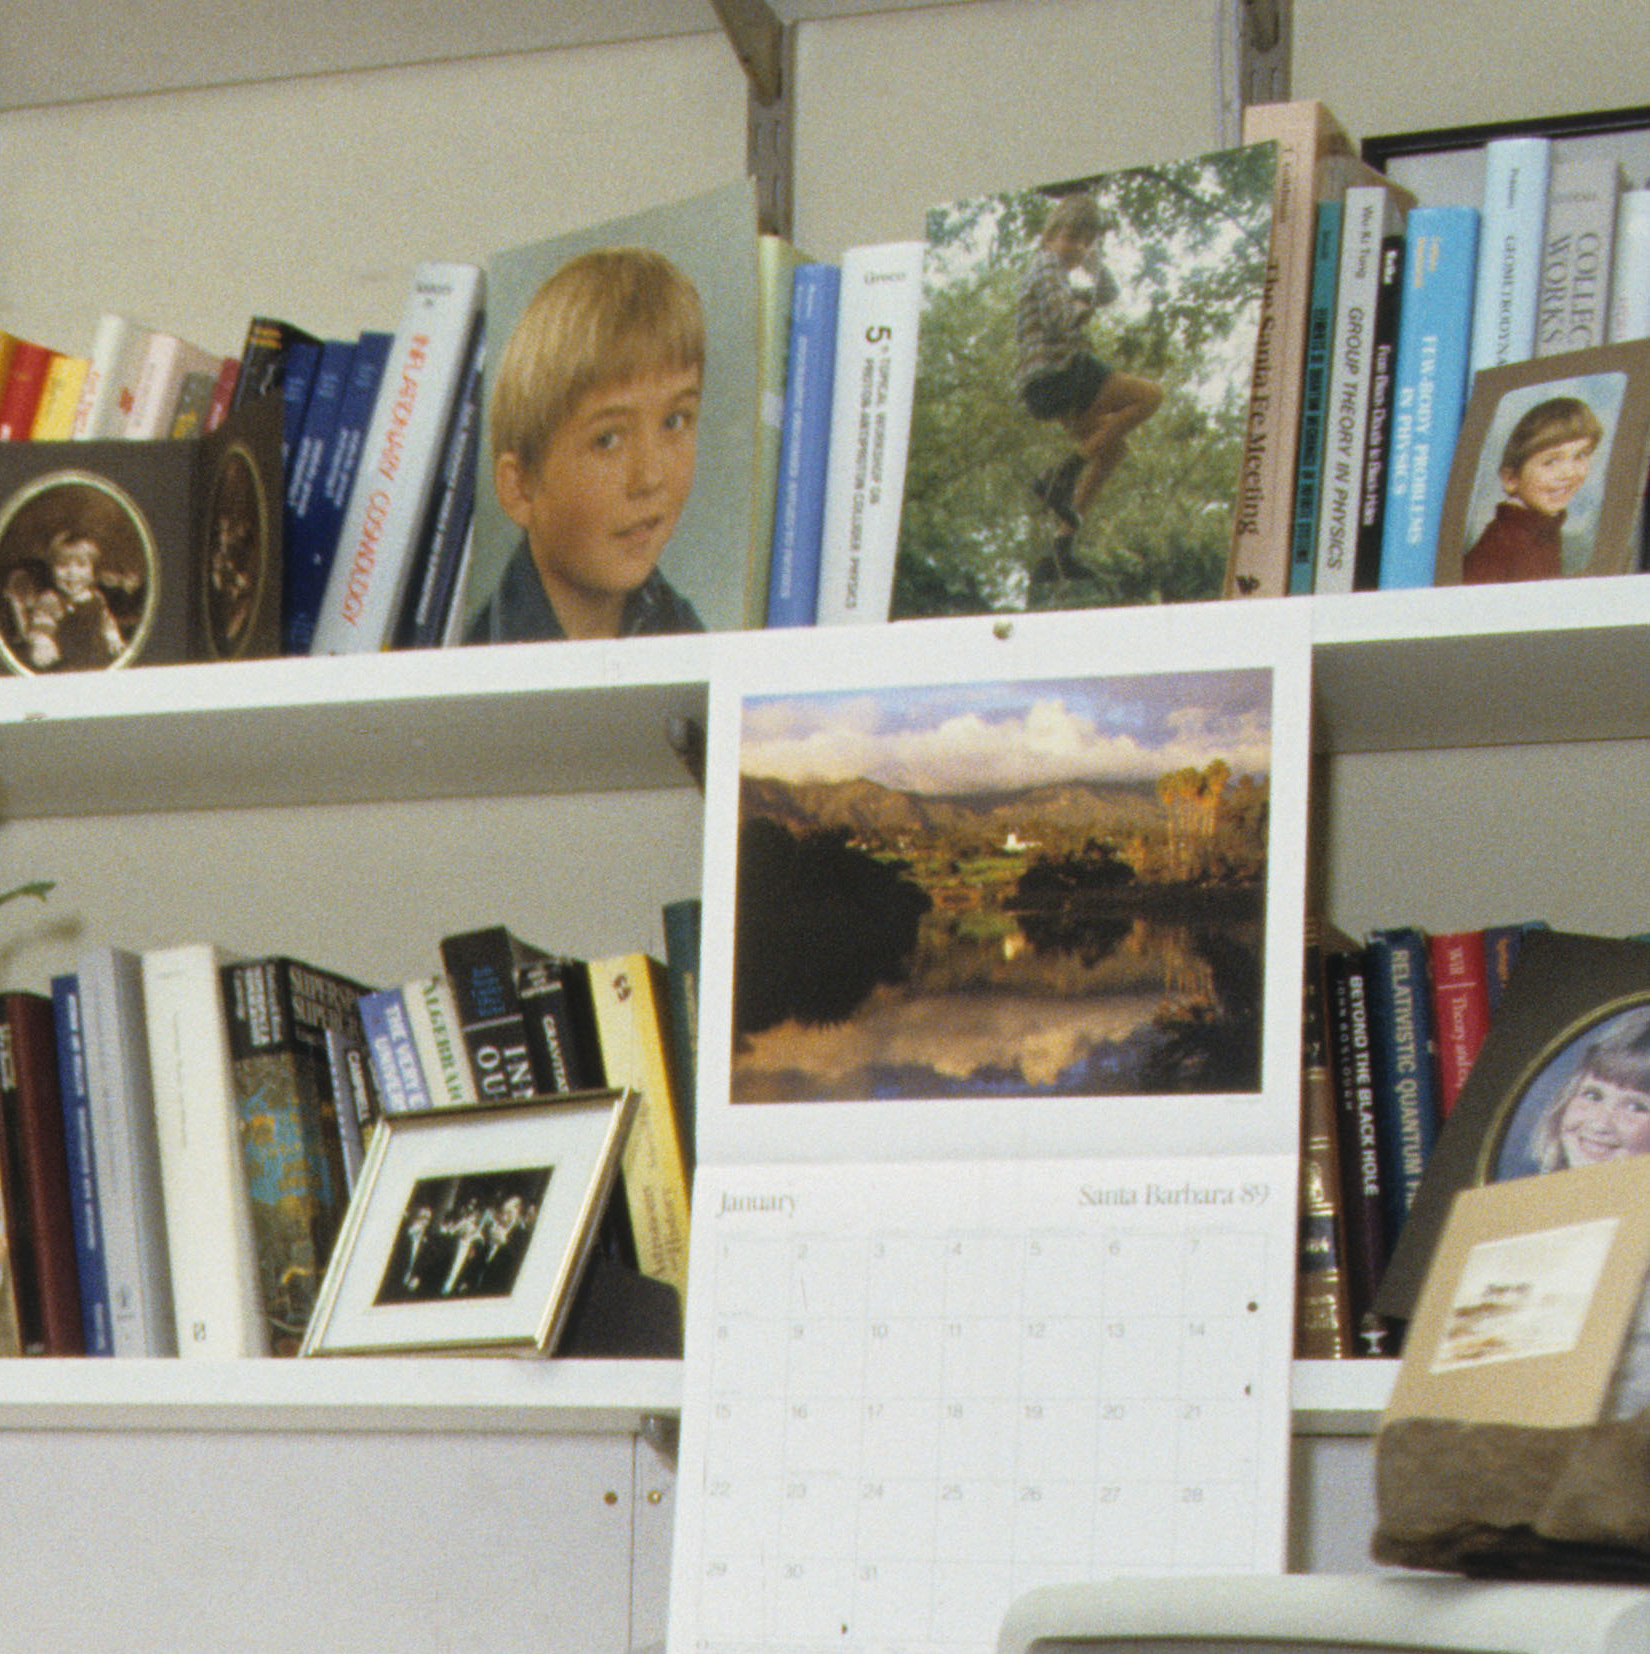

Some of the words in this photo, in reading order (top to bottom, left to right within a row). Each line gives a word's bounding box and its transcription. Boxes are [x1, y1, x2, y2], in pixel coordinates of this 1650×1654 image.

[1540, 233, 1573, 344] WORKS
[1345, 307, 1365, 375] GROUP
[1249, 394, 1271, 426] Fe
[1400, 386, 1416, 408] IN
[1414, 335, 1439, 435] FEW-BODY
[1338, 382, 1361, 456] THEORY
[1335, 462, 1351, 483] IN
[1392, 414, 1416, 496] PHYSICS
[1236, 432, 1268, 536] Meeting
[1406, 443, 1435, 545] PROBLEMS
[1327, 489, 1348, 569] PHYSICS
[341, 490, 391, 626] COSMOLOGY
[1448, 946, 1466, 976] Will
[388, 1002, 411, 1042] THE
[1336, 981, 1348, 1018] JOHN
[1349, 976, 1369, 1048] BEYOND
[1391, 948, 1417, 1073] RELATIVISTIC
[1450, 993, 1469, 1041] Theory
[1339, 1022, 1354, 1111] BOSLOUGH
[1356, 1052, 1371, 1084] THE
[1357, 1088, 1376, 1147] BLACK
[1394, 1079, 1423, 1175] QUANTUM
[1362, 1150, 1380, 1196] HOLE
[715, 1190, 797, 1219] January
[1078, 1184, 1138, 1207] Santa
[1144, 1182, 1235, 1207] Barbara
[1239, 1183, 1271, 1207] 89
[870, 1322, 889, 1339] 10
[948, 1321, 962, 1337] 11
[1027, 1321, 1046, 1338] 12
[1107, 1321, 1126, 1338] 13
[1188, 1321, 1206, 1337] 14
[714, 1402, 732, 1419] 15
[791, 1402, 809, 1420] 16
[867, 1402, 884, 1419] 17
[947, 1402, 964, 1419] 18
[1024, 1403, 1043, 1420] 19
[1102, 1403, 1126, 1420] 20
[1182, 1403, 1202, 1420] 21
[709, 1480, 732, 1498] 22
[786, 1481, 808, 1500] 23
[862, 1482, 884, 1500] 24
[941, 1482, 964, 1501] 25
[1020, 1485, 1043, 1502] 26
[1100, 1485, 1122, 1503] 27
[1181, 1486, 1204, 1503] 28
[705, 1560, 728, 1578] 29
[783, 1562, 805, 1580] 30
[858, 1563, 879, 1581] 31
